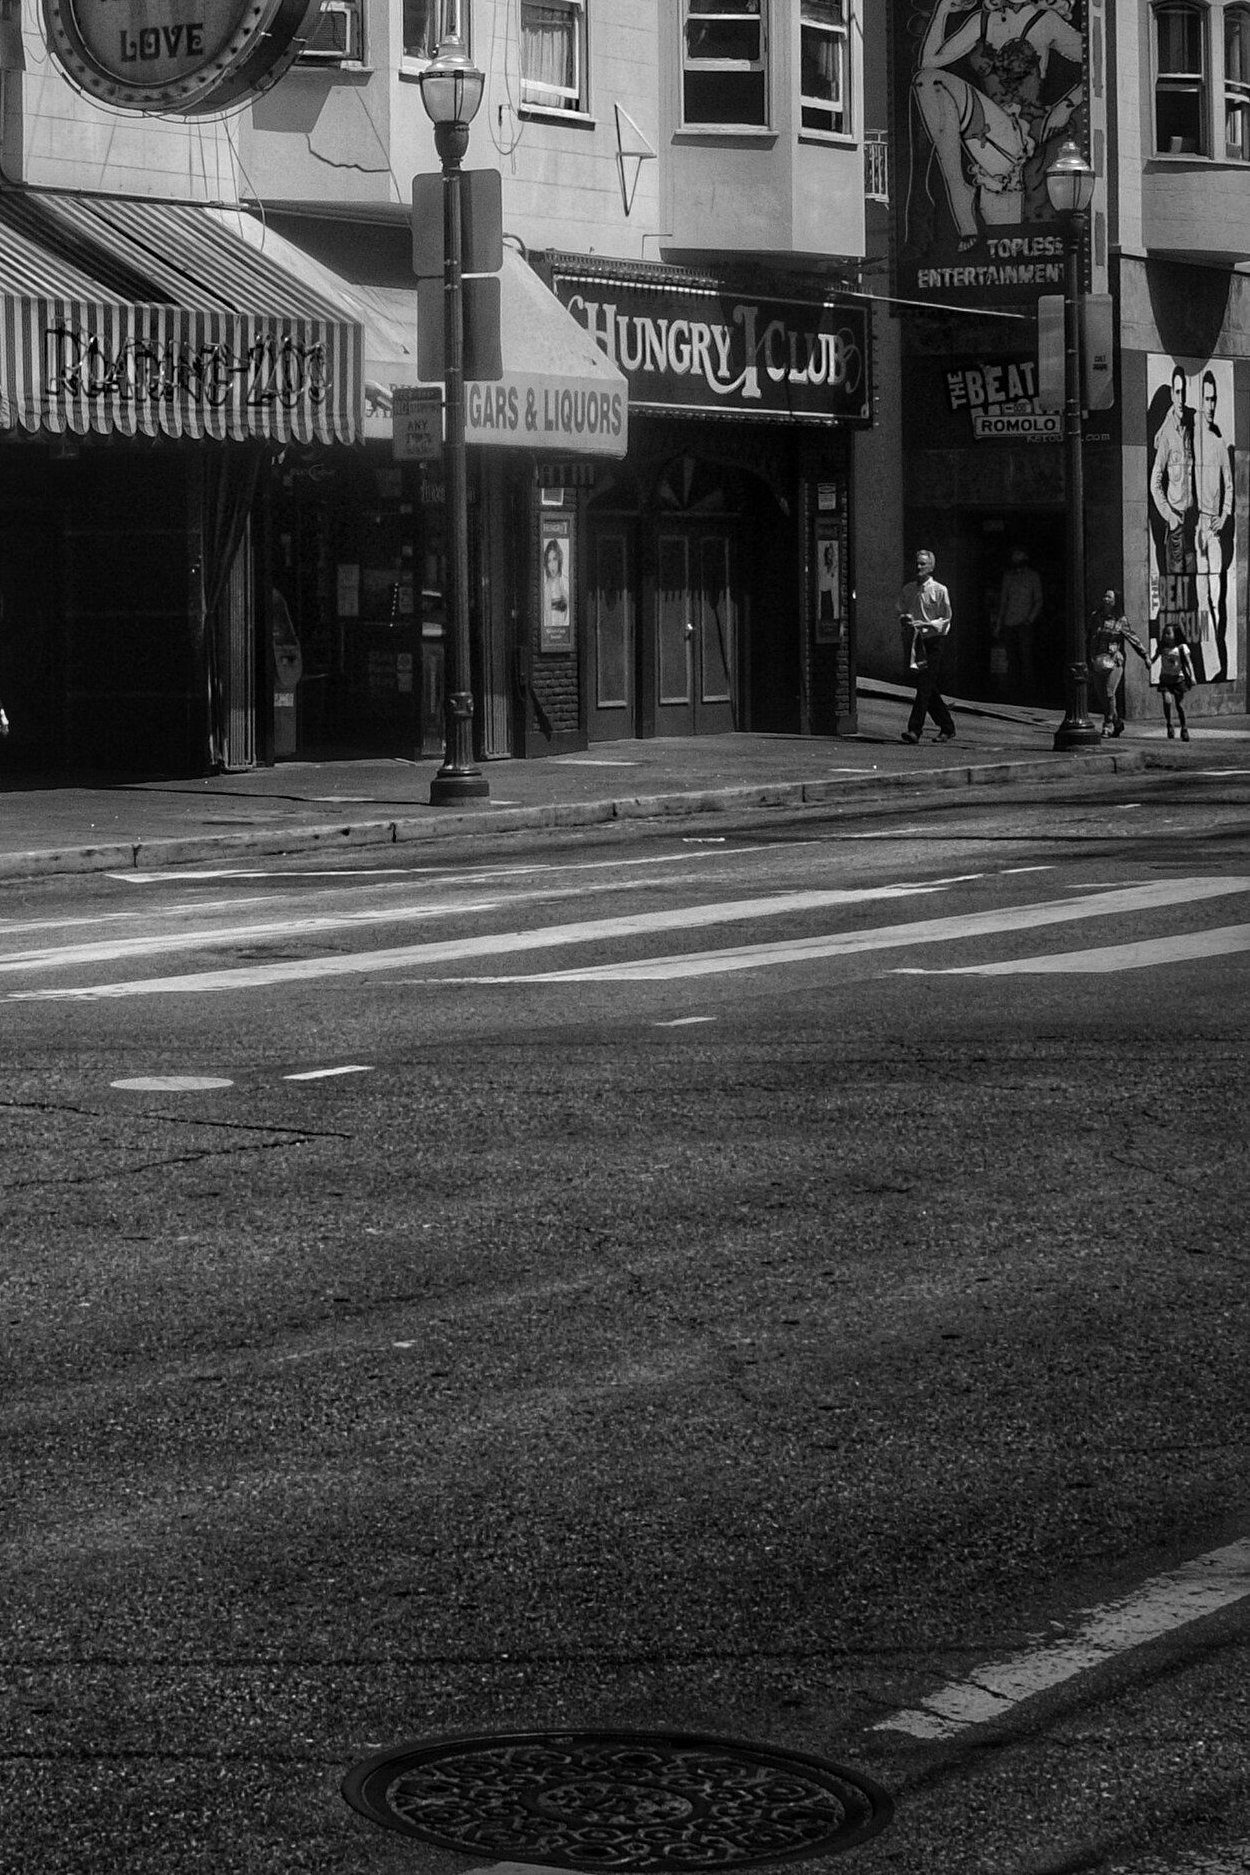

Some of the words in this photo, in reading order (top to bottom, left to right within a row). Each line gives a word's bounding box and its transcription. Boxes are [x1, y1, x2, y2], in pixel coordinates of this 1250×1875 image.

[119, 22, 203, 62] LOVE
[986, 236, 1065, 259] TOPLESS
[570, 294, 746, 397] HUNGRY
[763, 319, 862, 395] CLUB
[946, 370, 967, 410] THE
[964, 361, 1036, 406] BEAT
[464, 382, 520, 431] GARS
[524, 386, 539, 432] &
[543, 389, 623, 437] LIQUORS
[981, 419, 1056, 432] ROMOLO
